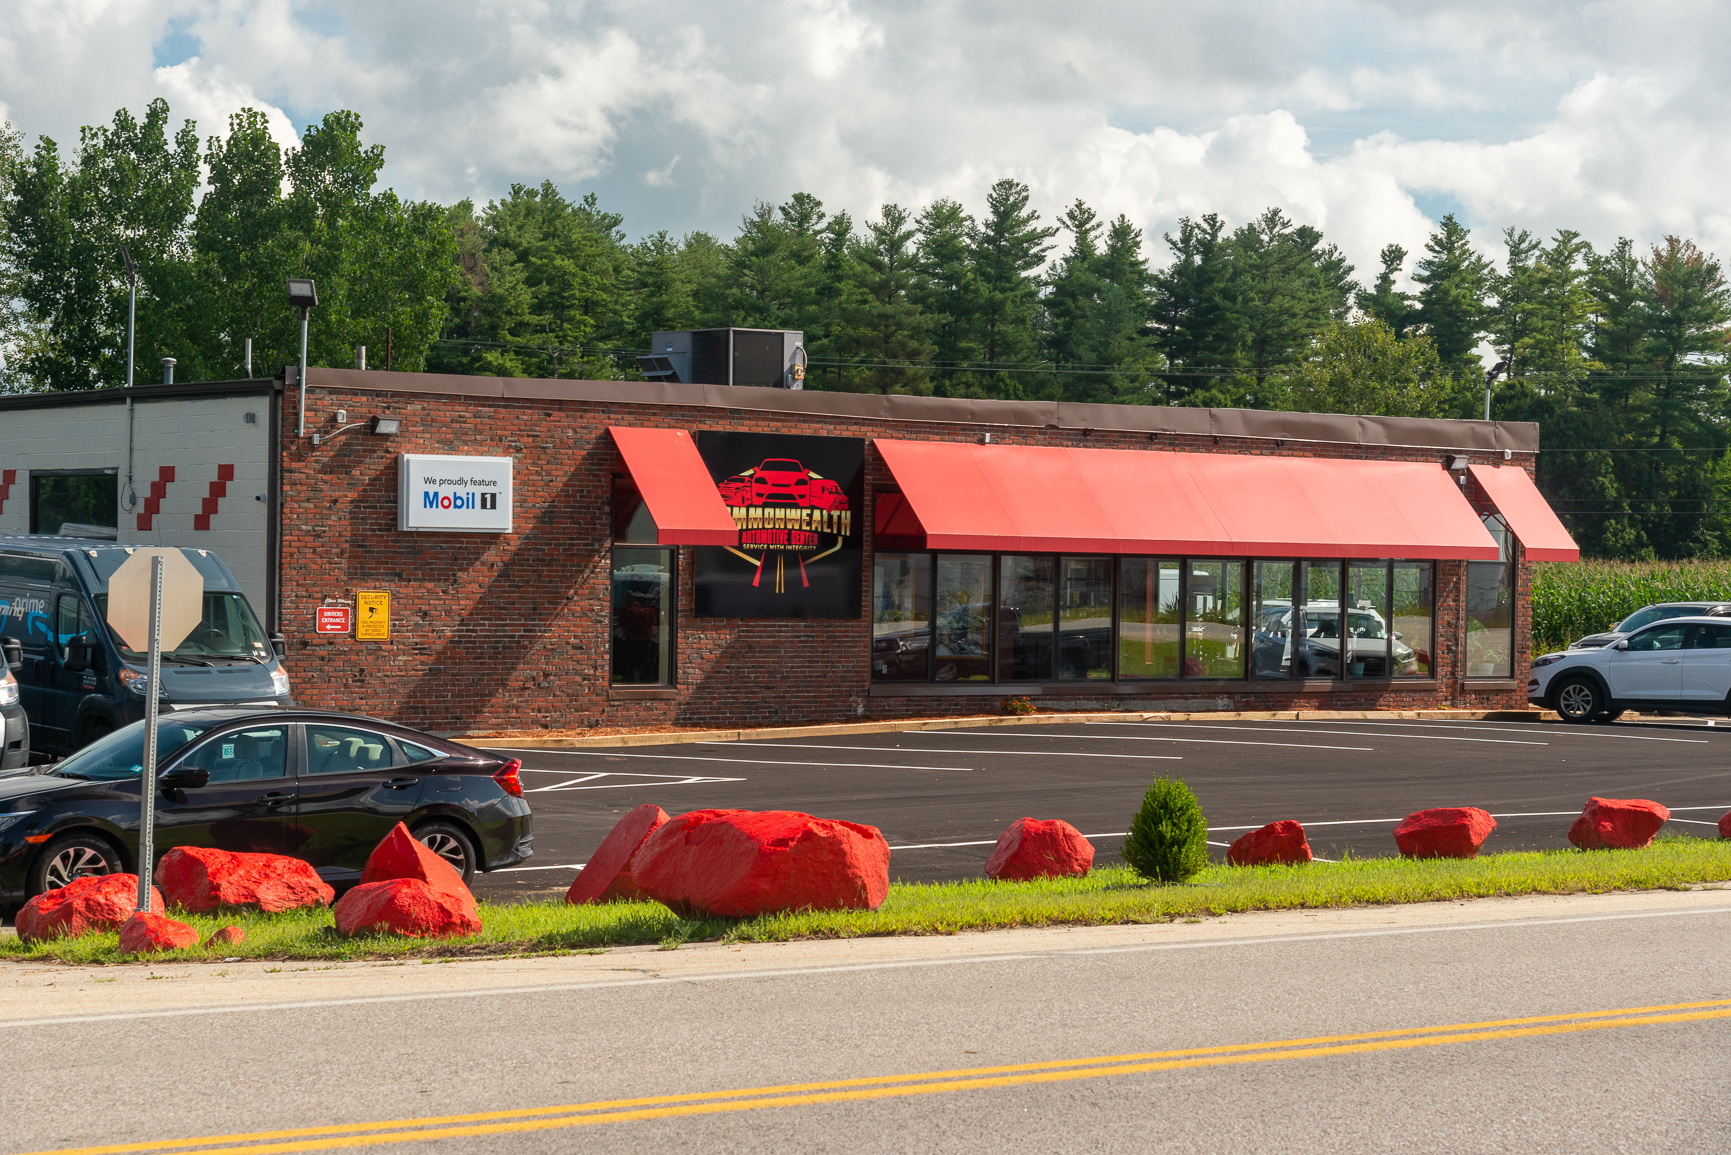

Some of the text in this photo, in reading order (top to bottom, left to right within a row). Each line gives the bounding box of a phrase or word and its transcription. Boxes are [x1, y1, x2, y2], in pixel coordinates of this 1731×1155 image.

[423, 476, 498, 488] We proudly feature
[424, 491, 494, 510] Mobil 1
[727, 506, 851, 536] MMONWEALTH
[742, 529, 818, 546] AUTOMOTIVE CENTER
[13, 592, 44, 616] prime
